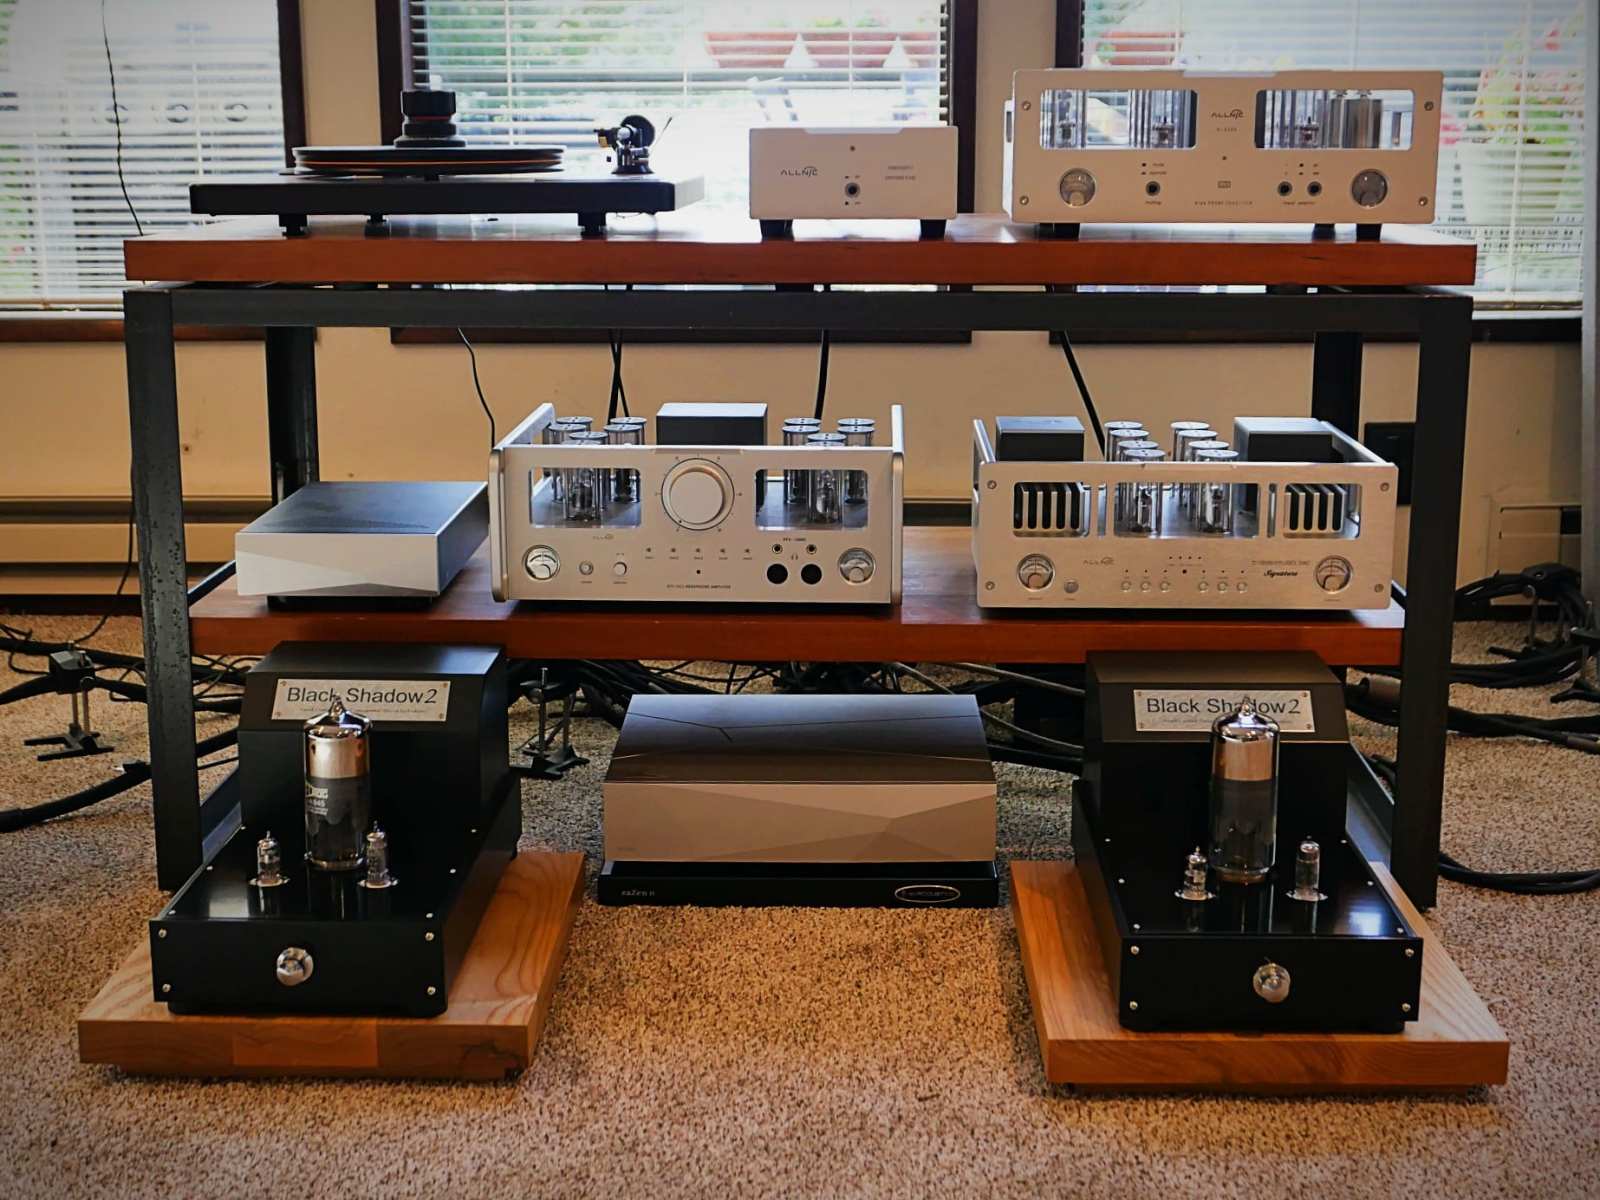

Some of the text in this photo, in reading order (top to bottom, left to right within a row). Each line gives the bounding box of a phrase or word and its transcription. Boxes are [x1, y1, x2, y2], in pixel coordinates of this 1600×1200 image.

[1210, 109, 1244, 120] ALLNIC
[780, 166, 818, 177] ALLNIC
[287, 687, 340, 702] Black
[1147, 698, 1200, 714] Black
